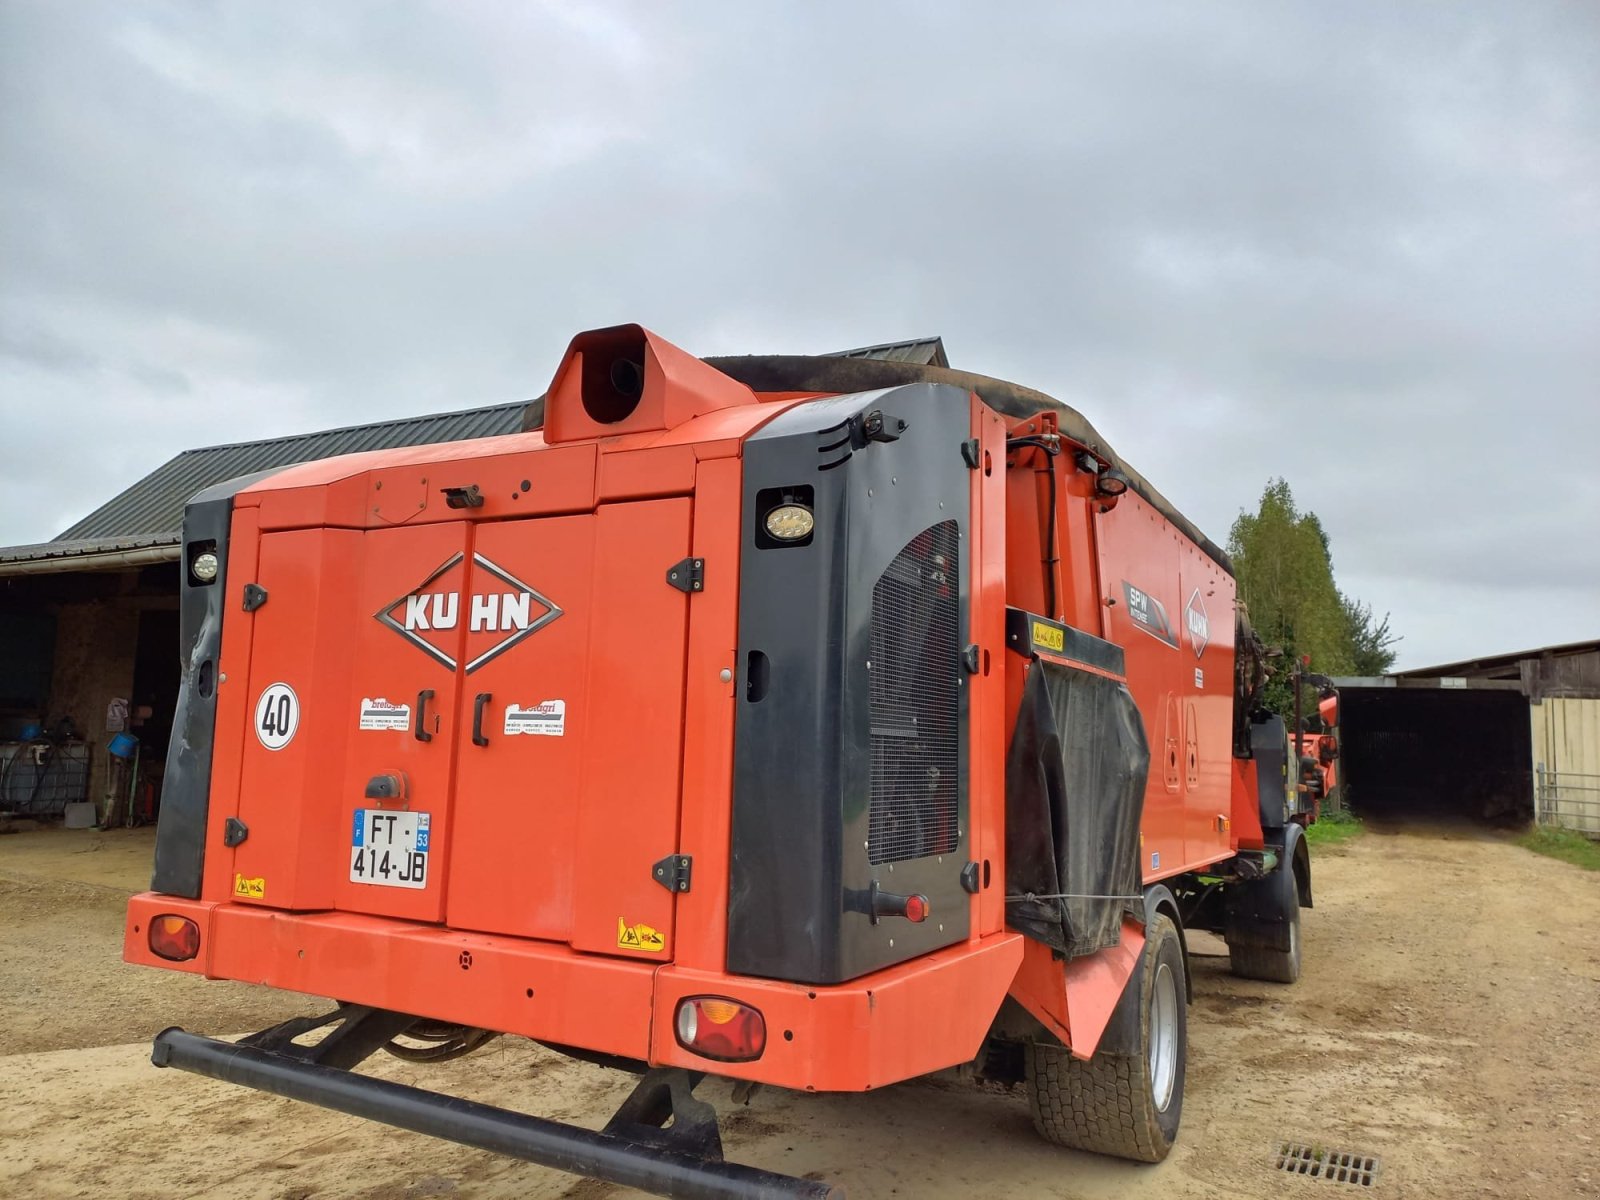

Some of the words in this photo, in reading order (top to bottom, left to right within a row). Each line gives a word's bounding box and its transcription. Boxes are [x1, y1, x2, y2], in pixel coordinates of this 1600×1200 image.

[1130, 587, 1148, 612] SPW
[1188, 607, 1208, 639] KUHN
[261, 694, 291, 737] 40
[355, 829, 361, 838] F
[417, 834, 428, 847] 53
